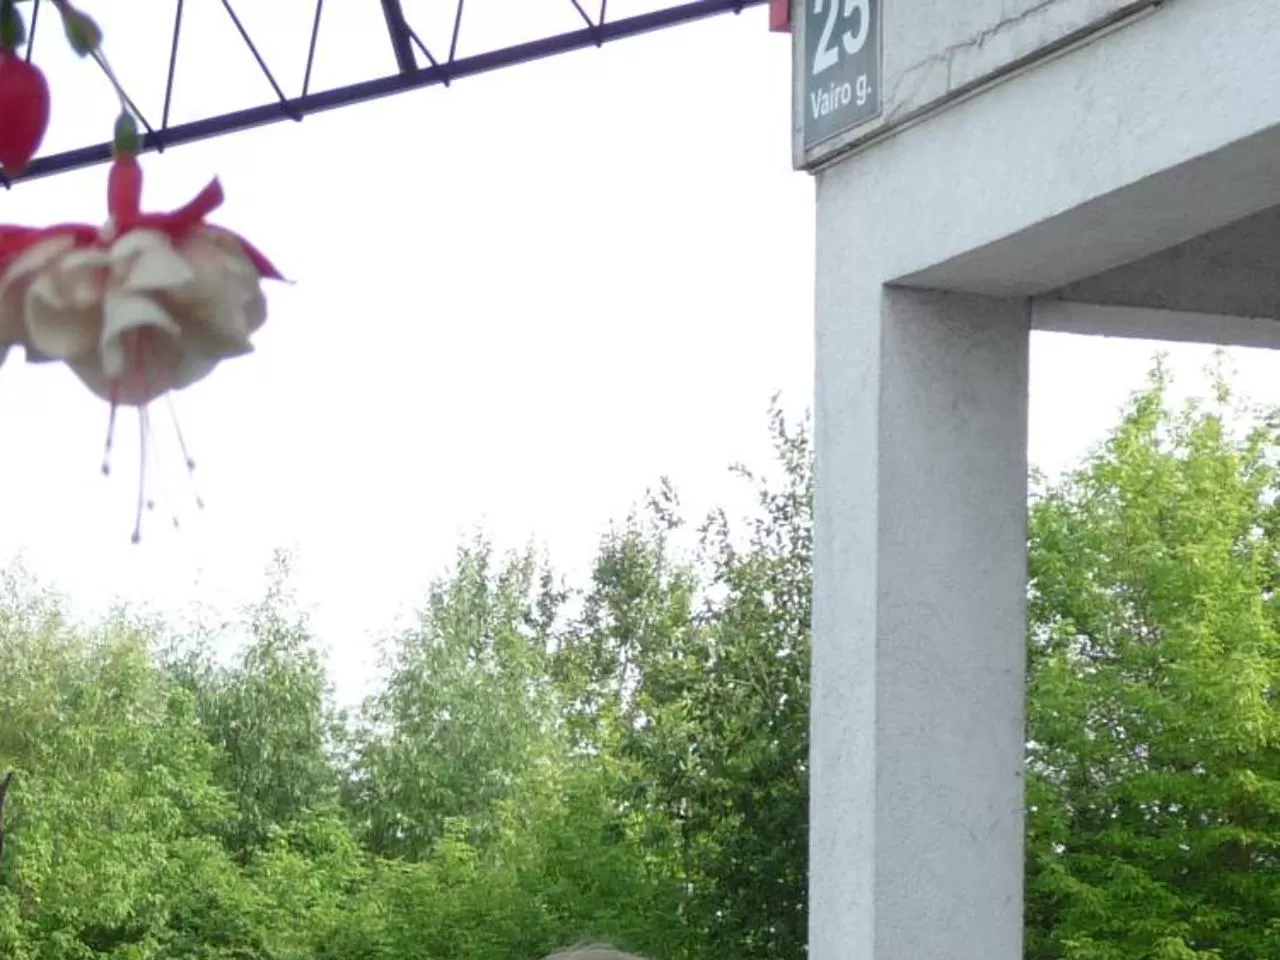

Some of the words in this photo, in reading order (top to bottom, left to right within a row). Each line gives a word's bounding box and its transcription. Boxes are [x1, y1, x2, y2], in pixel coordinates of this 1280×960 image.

[812, 0, 870, 75] 25
[810, 82, 851, 120] Vairo
[856, 74, 872, 106] g.
